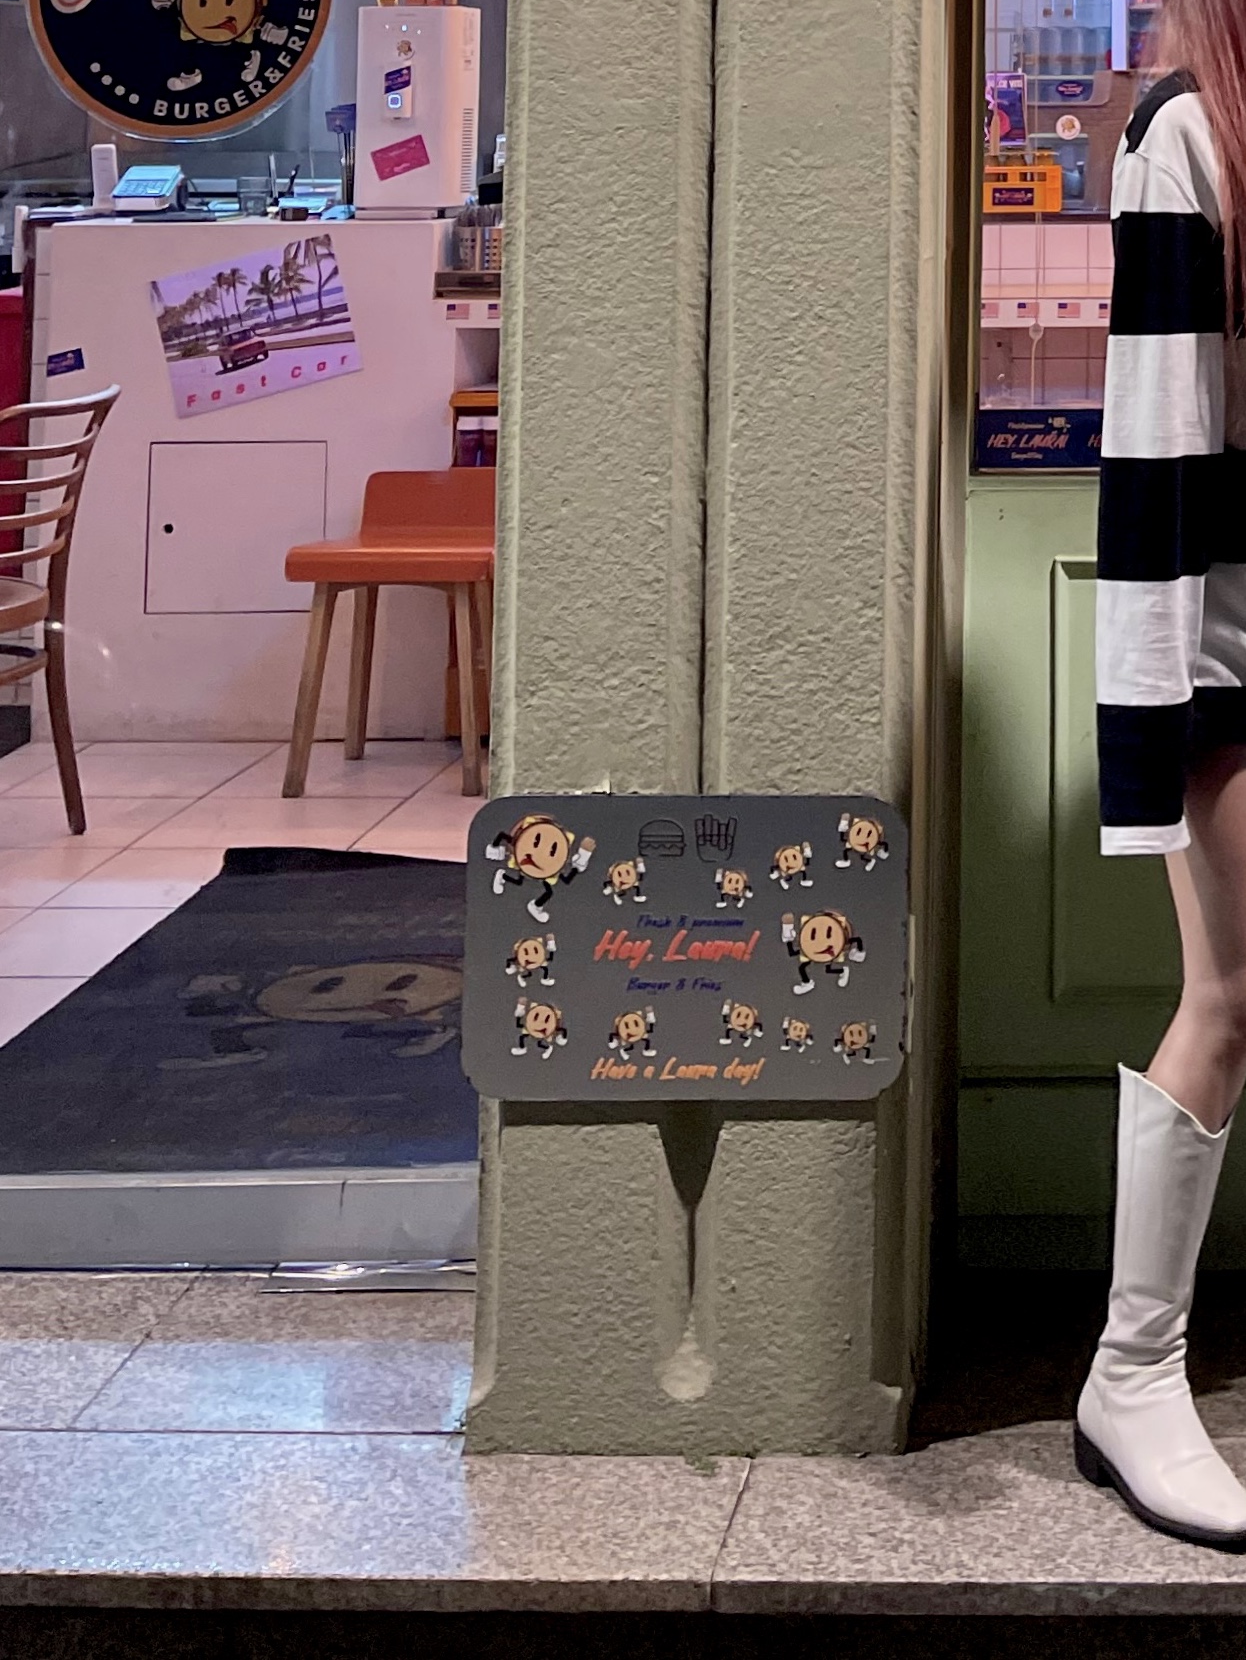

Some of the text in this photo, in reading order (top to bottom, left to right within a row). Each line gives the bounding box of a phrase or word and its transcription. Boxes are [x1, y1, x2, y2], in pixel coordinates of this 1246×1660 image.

[186, 355, 348, 408] Fast Car
[662, 929, 761, 963] Laura!
